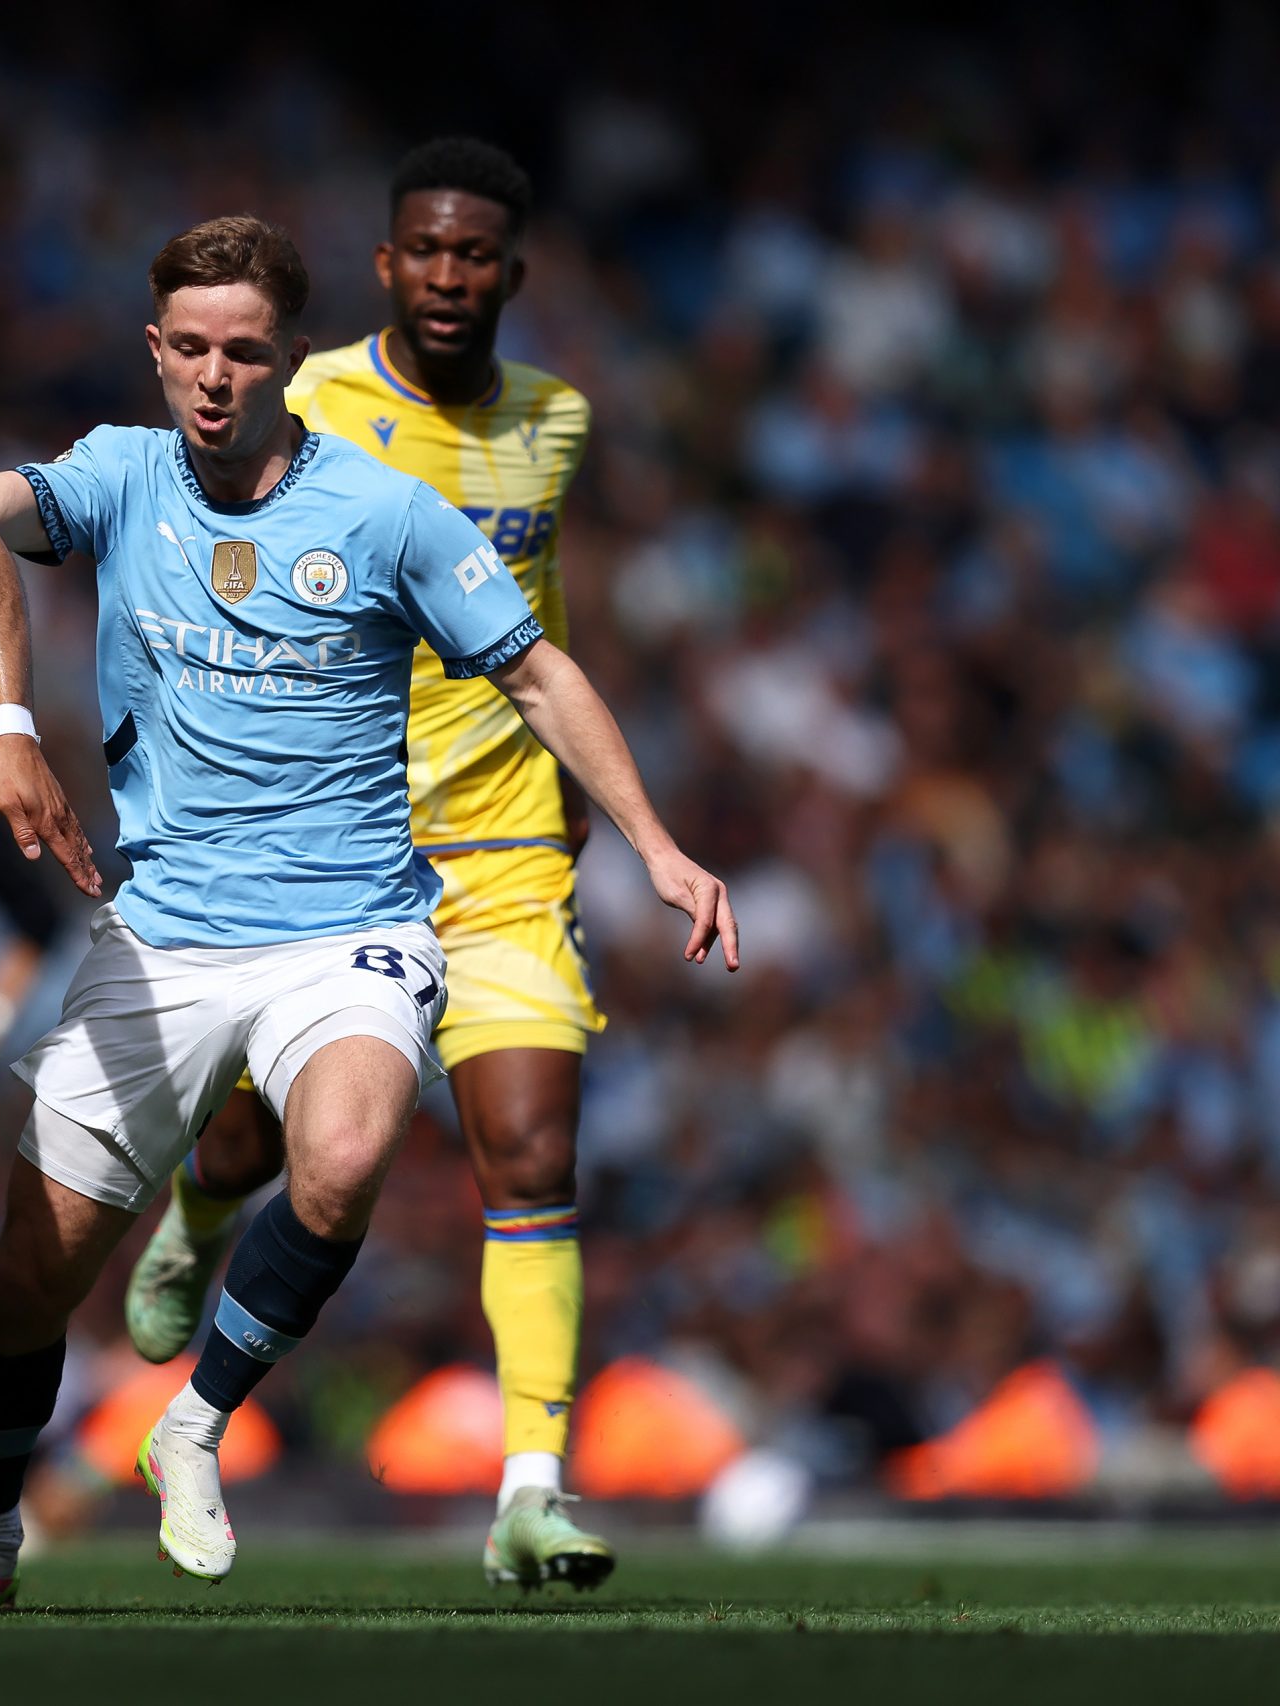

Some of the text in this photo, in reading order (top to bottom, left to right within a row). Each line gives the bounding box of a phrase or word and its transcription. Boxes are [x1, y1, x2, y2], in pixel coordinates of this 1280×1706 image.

[296, 553, 343, 571] MANCHESTER
[223, 581, 245, 589] FIFA
[311, 595, 329, 603] CITY
[135, 608, 362, 671] ETIHAD
[176, 667, 318, 695] AIRWAYS
[350, 944, 439, 1008] 87
